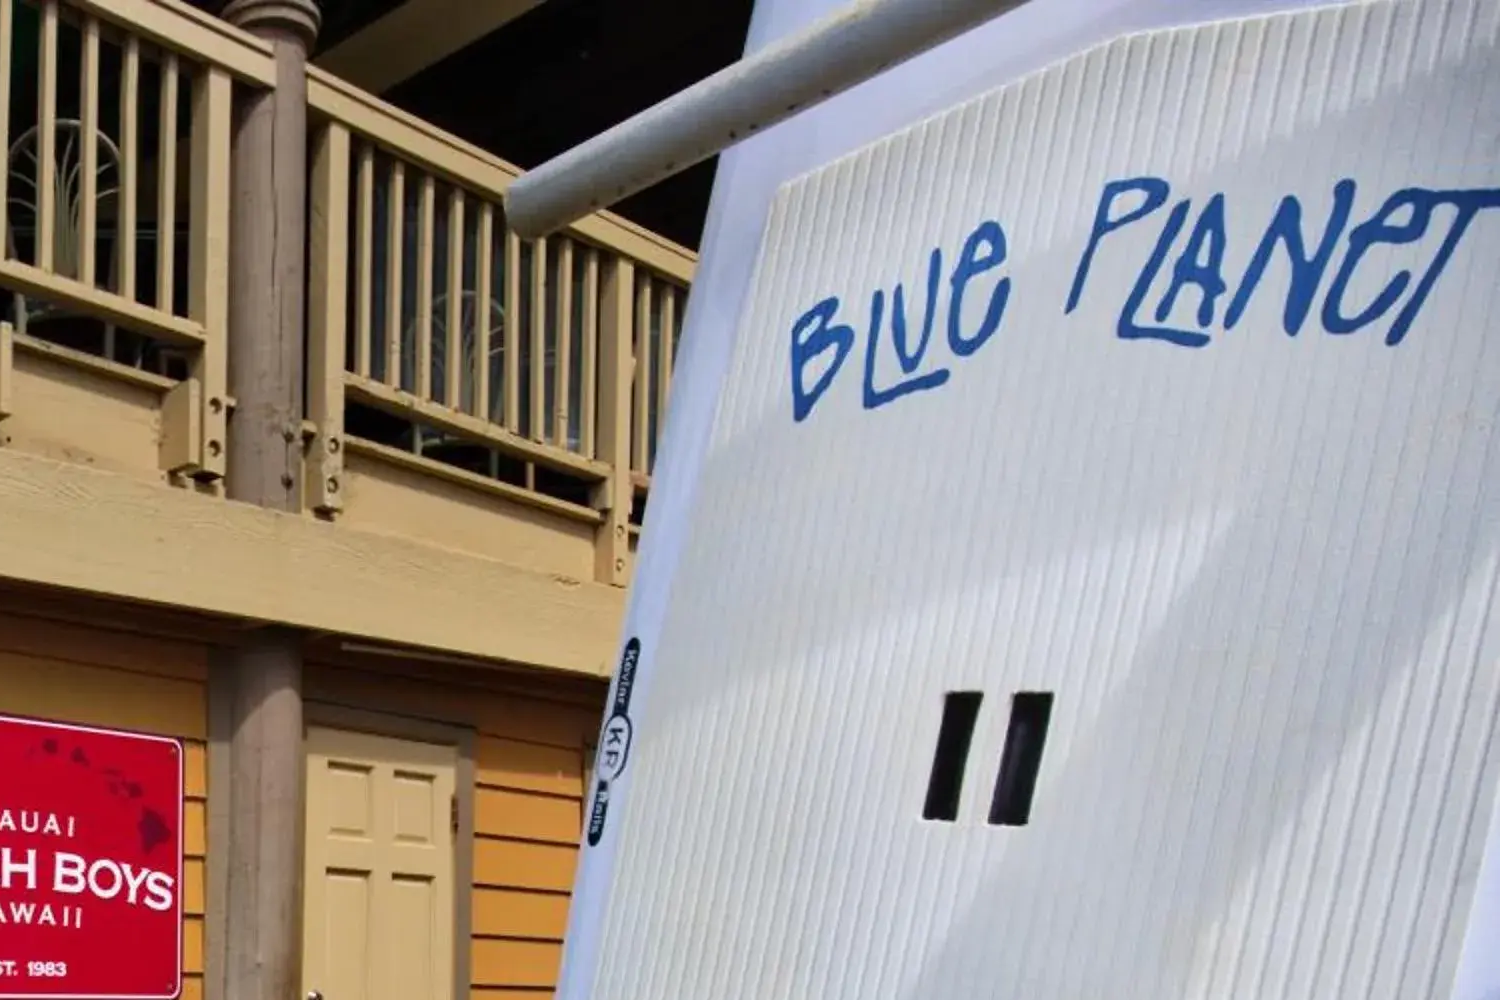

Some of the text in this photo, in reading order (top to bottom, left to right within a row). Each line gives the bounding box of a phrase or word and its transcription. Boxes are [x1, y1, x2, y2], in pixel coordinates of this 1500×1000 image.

[616, 650, 637, 705] Kevlar
[53, 851, 175, 911] BOYS
[27, 961, 67, 978] 1983
